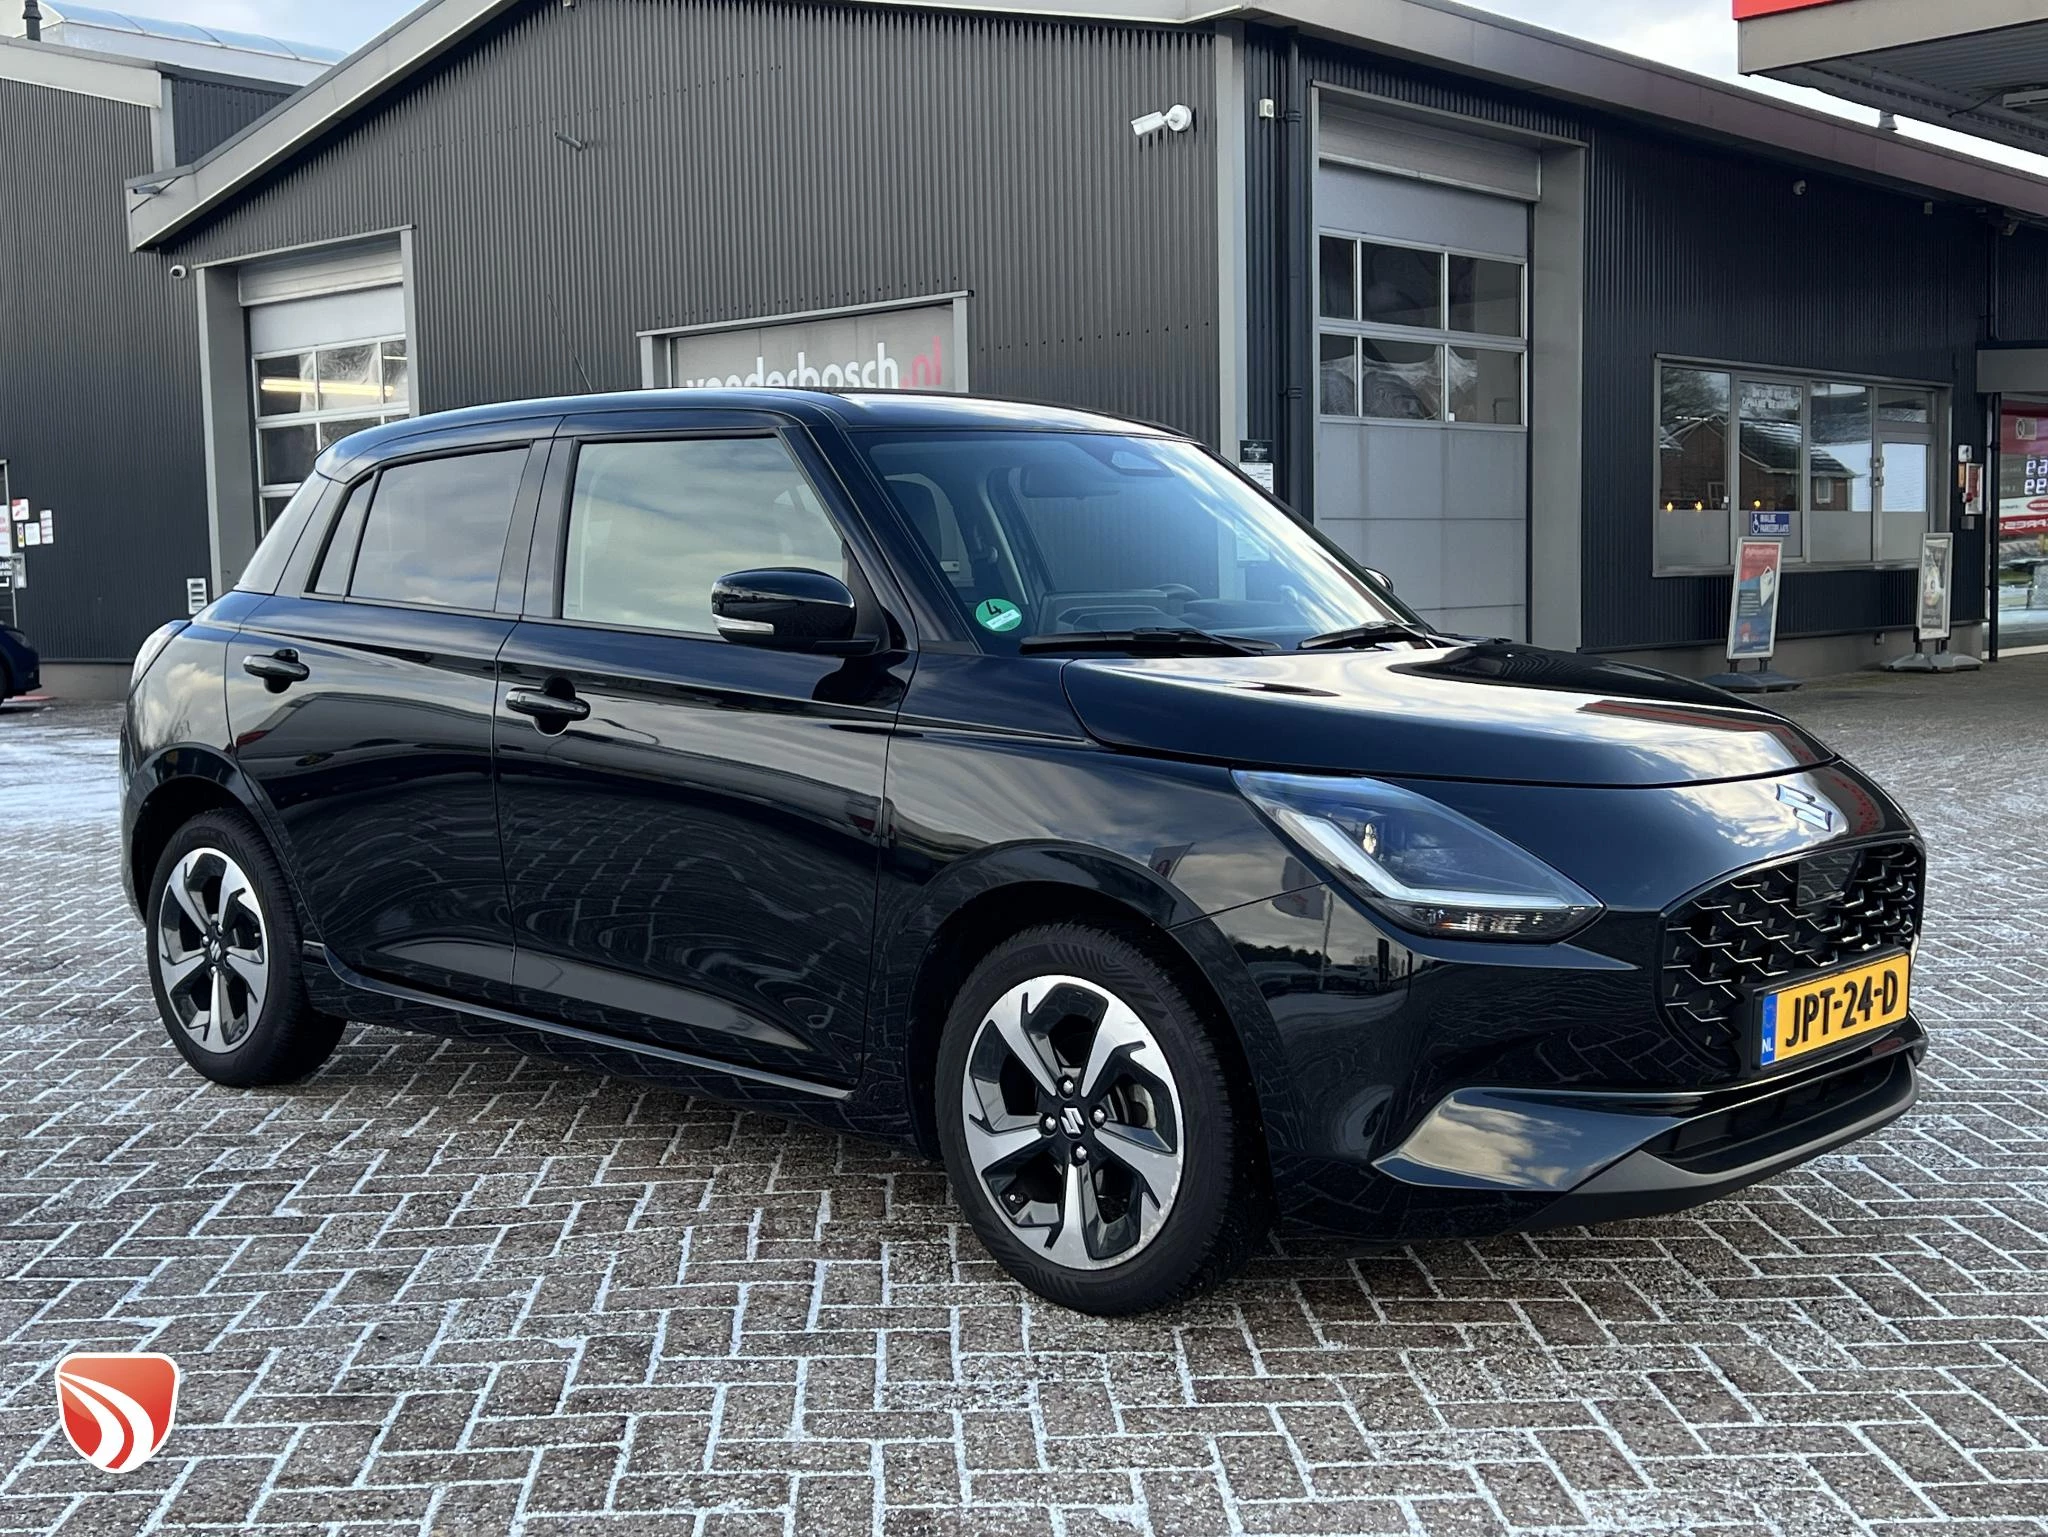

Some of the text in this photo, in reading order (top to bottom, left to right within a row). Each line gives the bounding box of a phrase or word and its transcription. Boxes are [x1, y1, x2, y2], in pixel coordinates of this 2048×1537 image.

[686, 336, 943, 389] derbosch.nl
[985, 601, 1003, 616] 4
[1785, 969, 1898, 1048] JPT-24-D
[1761, 1037, 1774, 1054] NL
